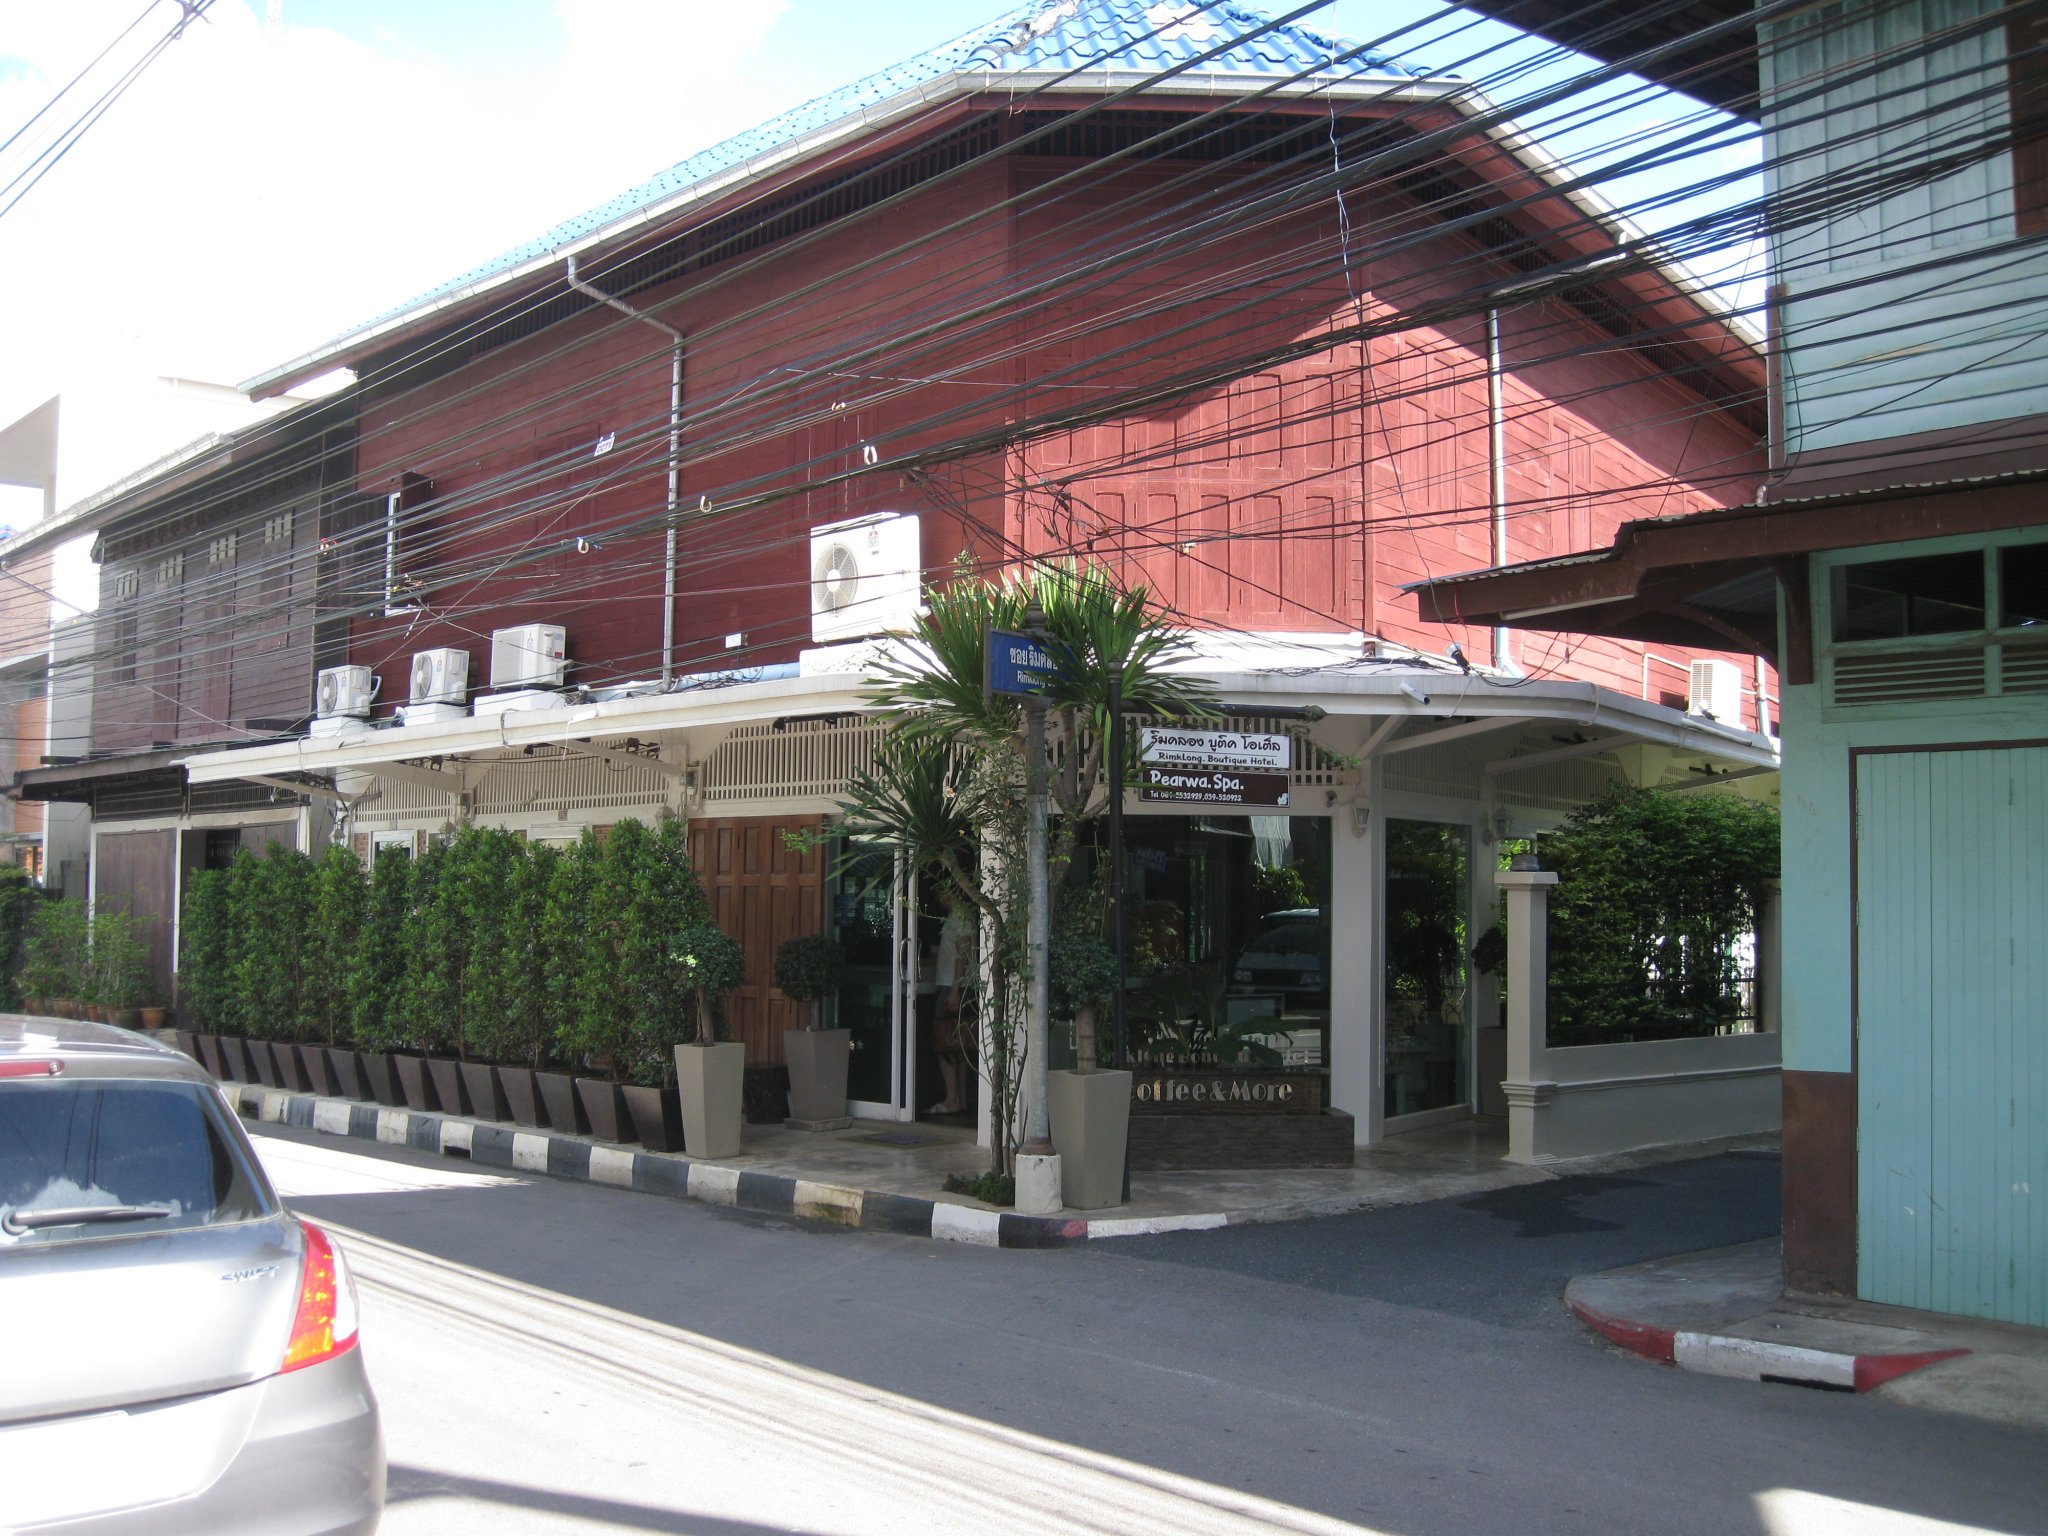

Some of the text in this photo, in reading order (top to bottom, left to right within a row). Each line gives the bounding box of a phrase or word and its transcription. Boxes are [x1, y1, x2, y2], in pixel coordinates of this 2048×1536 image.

[1207, 755, 1247, 767] Boutique
[1150, 790, 1159, 798] Tel
[221, 1265, 280, 1282] SWIFT
